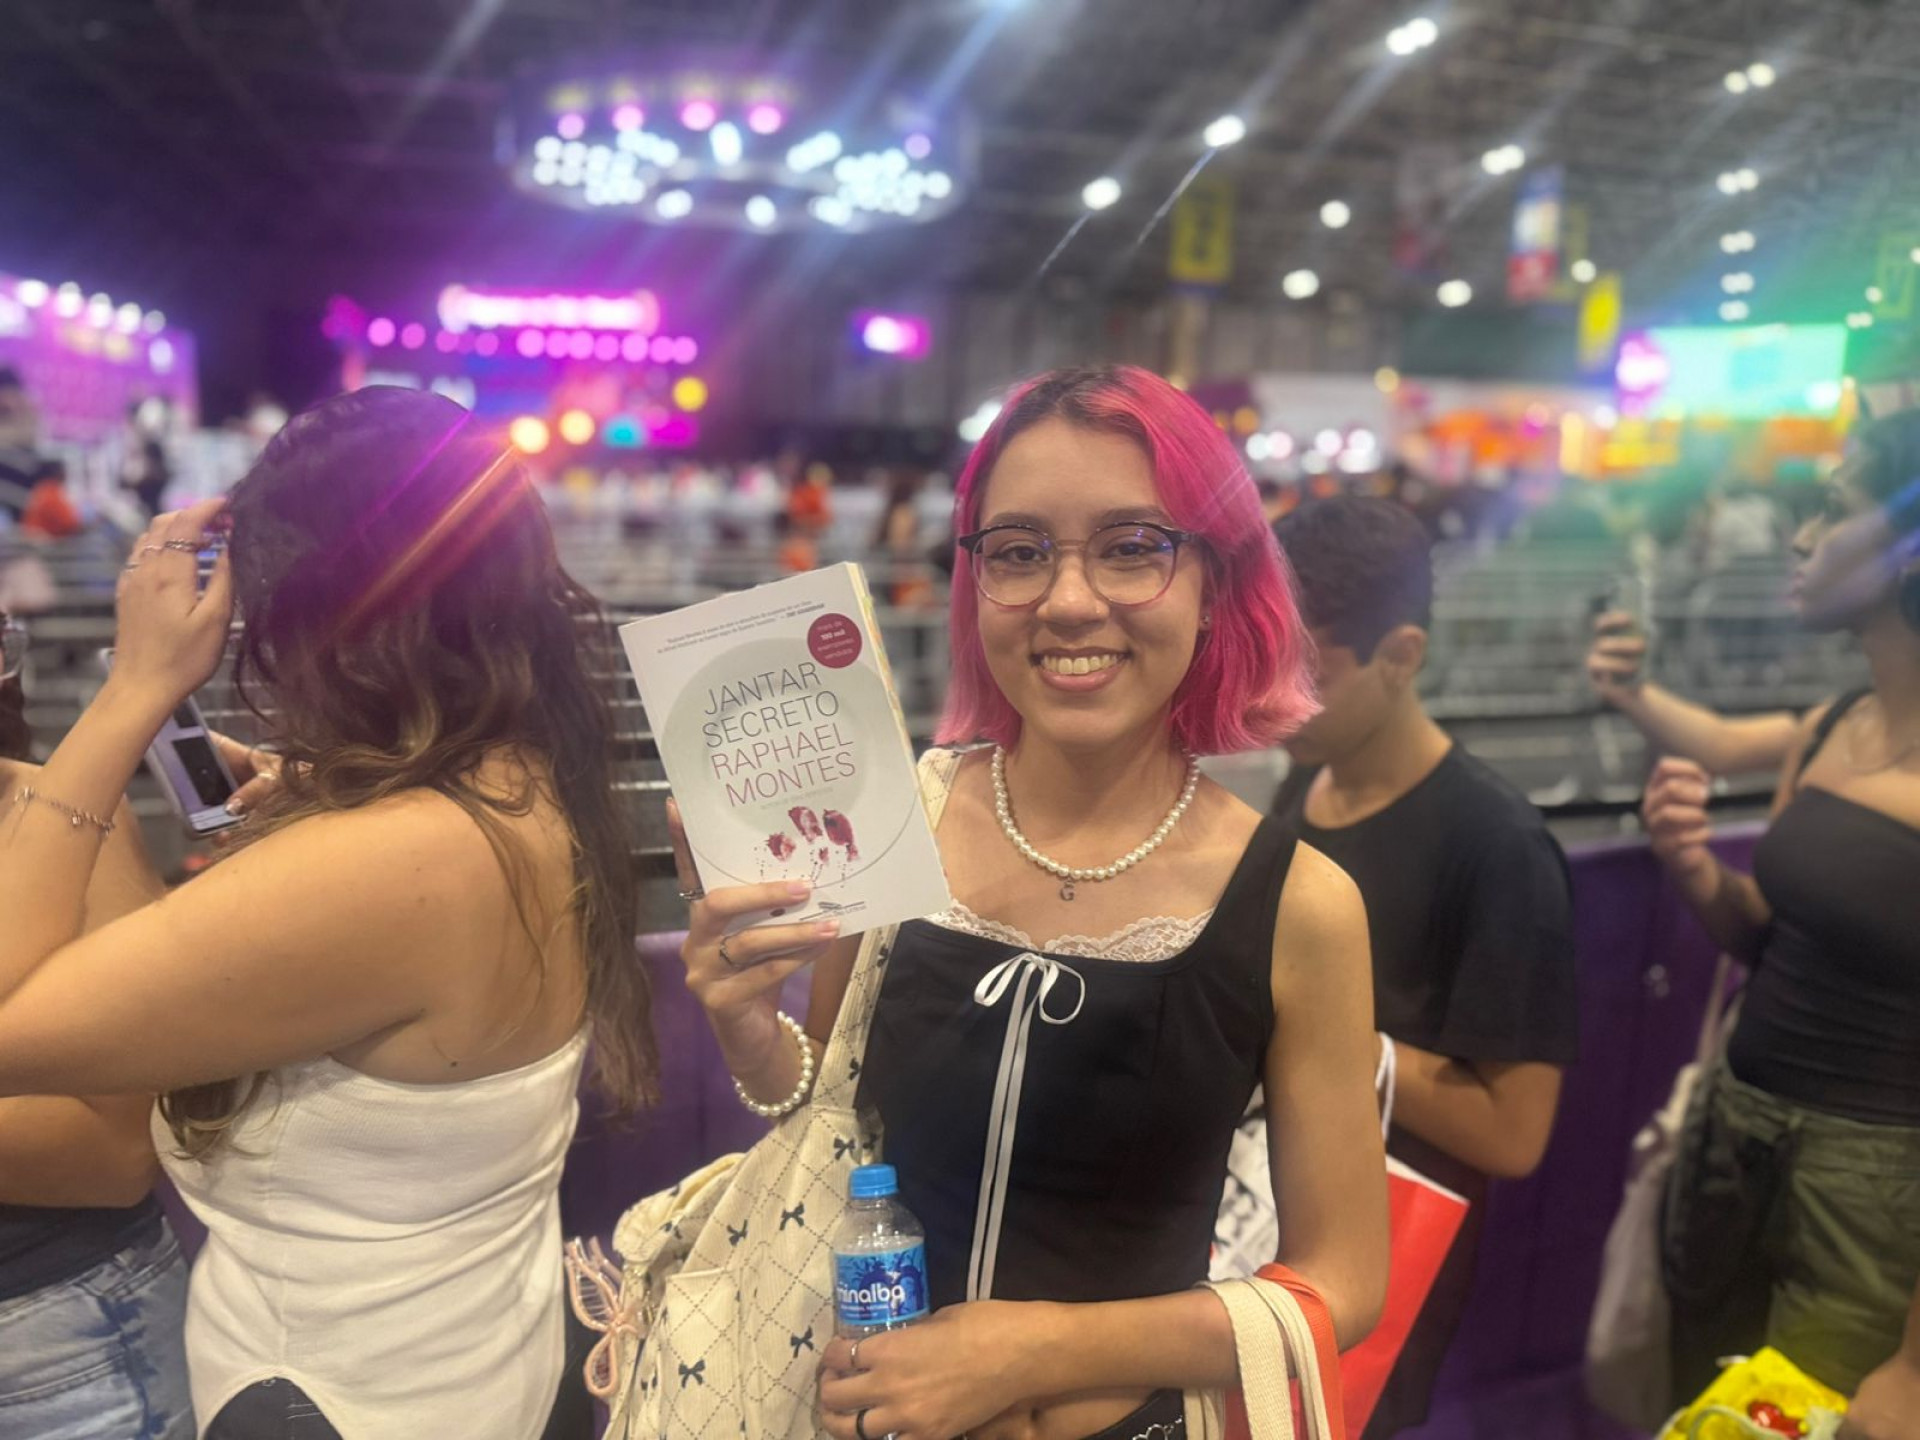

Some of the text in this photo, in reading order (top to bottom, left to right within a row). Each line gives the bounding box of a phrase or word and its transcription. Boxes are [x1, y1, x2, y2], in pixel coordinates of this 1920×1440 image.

[704, 662, 822, 715] JANTAR
[702, 690, 839, 748] SECRETO
[711, 723, 854, 780] RAPHAEL
[725, 751, 856, 807] MONTES
